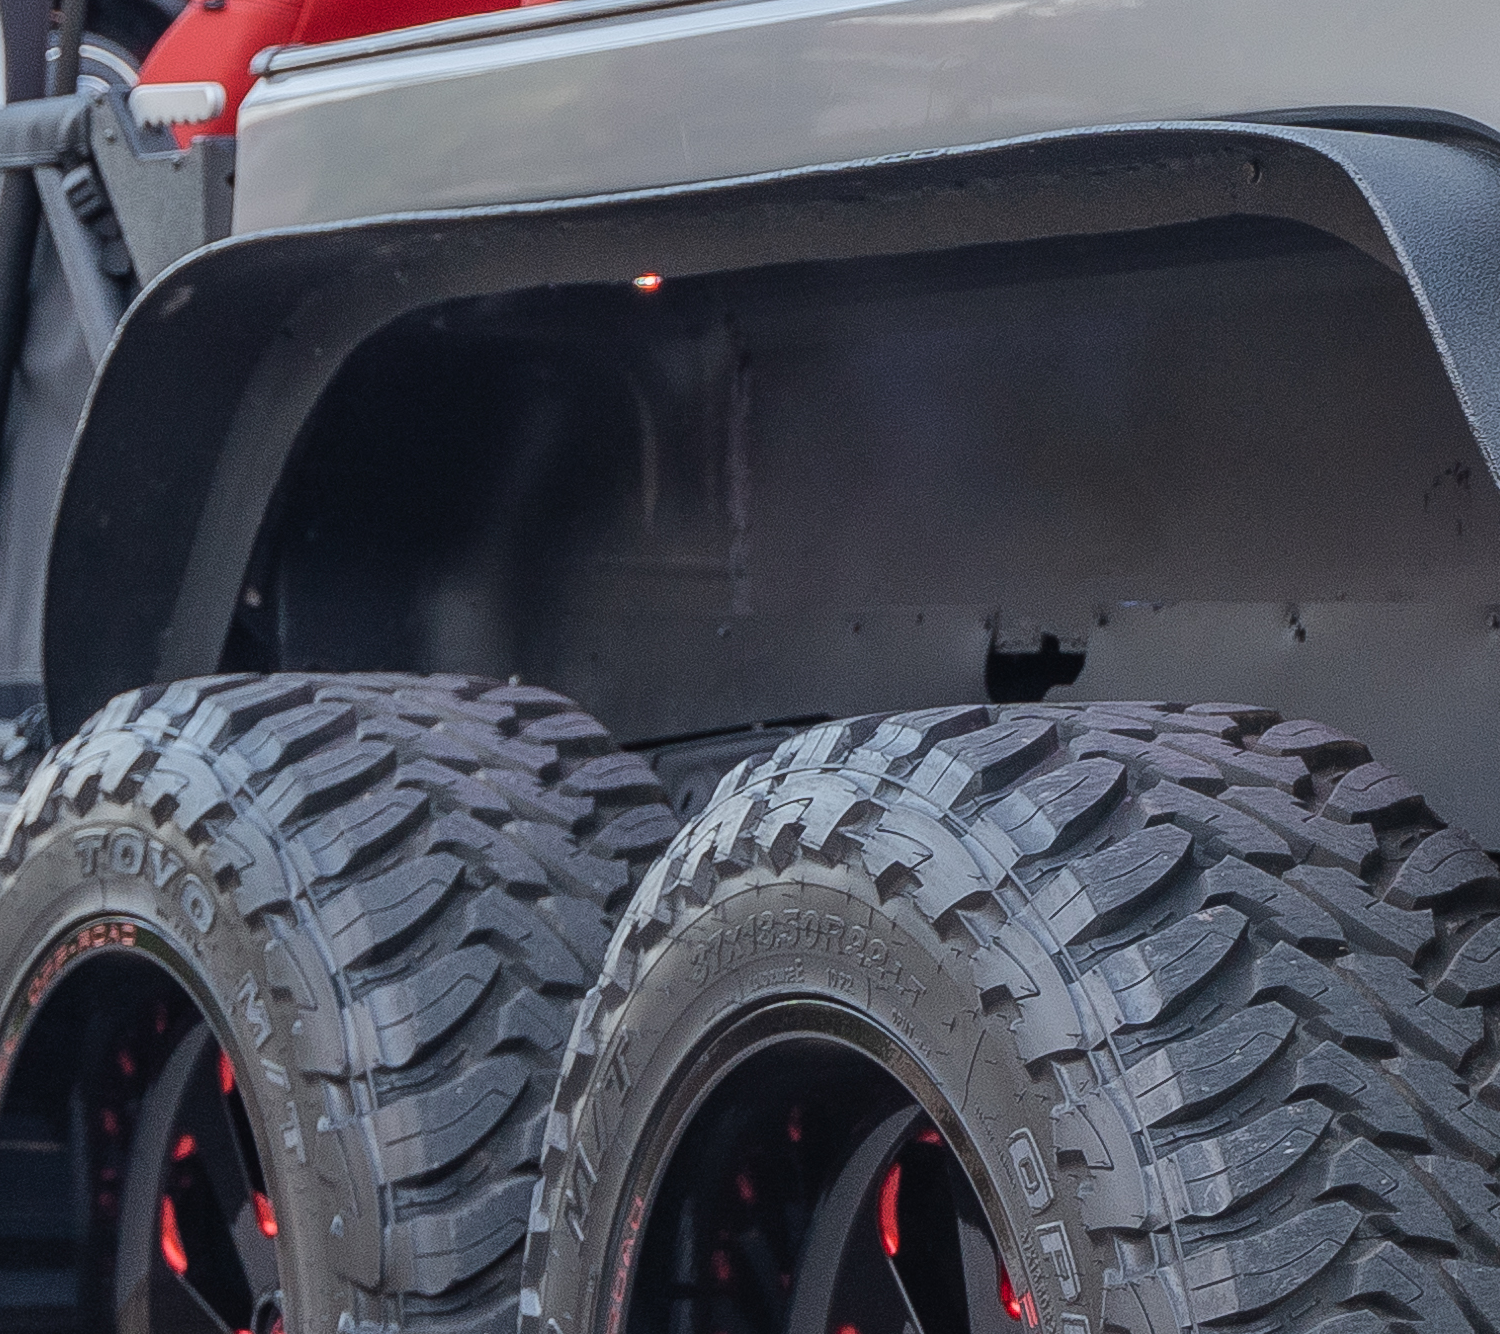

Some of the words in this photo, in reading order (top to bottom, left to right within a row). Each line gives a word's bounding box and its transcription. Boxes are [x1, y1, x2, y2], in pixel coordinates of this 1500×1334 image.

[73, 825, 217, 935] TOYO
[235, 969, 306, 1166] M/T
[564, 1033, 636, 1245] M/T
